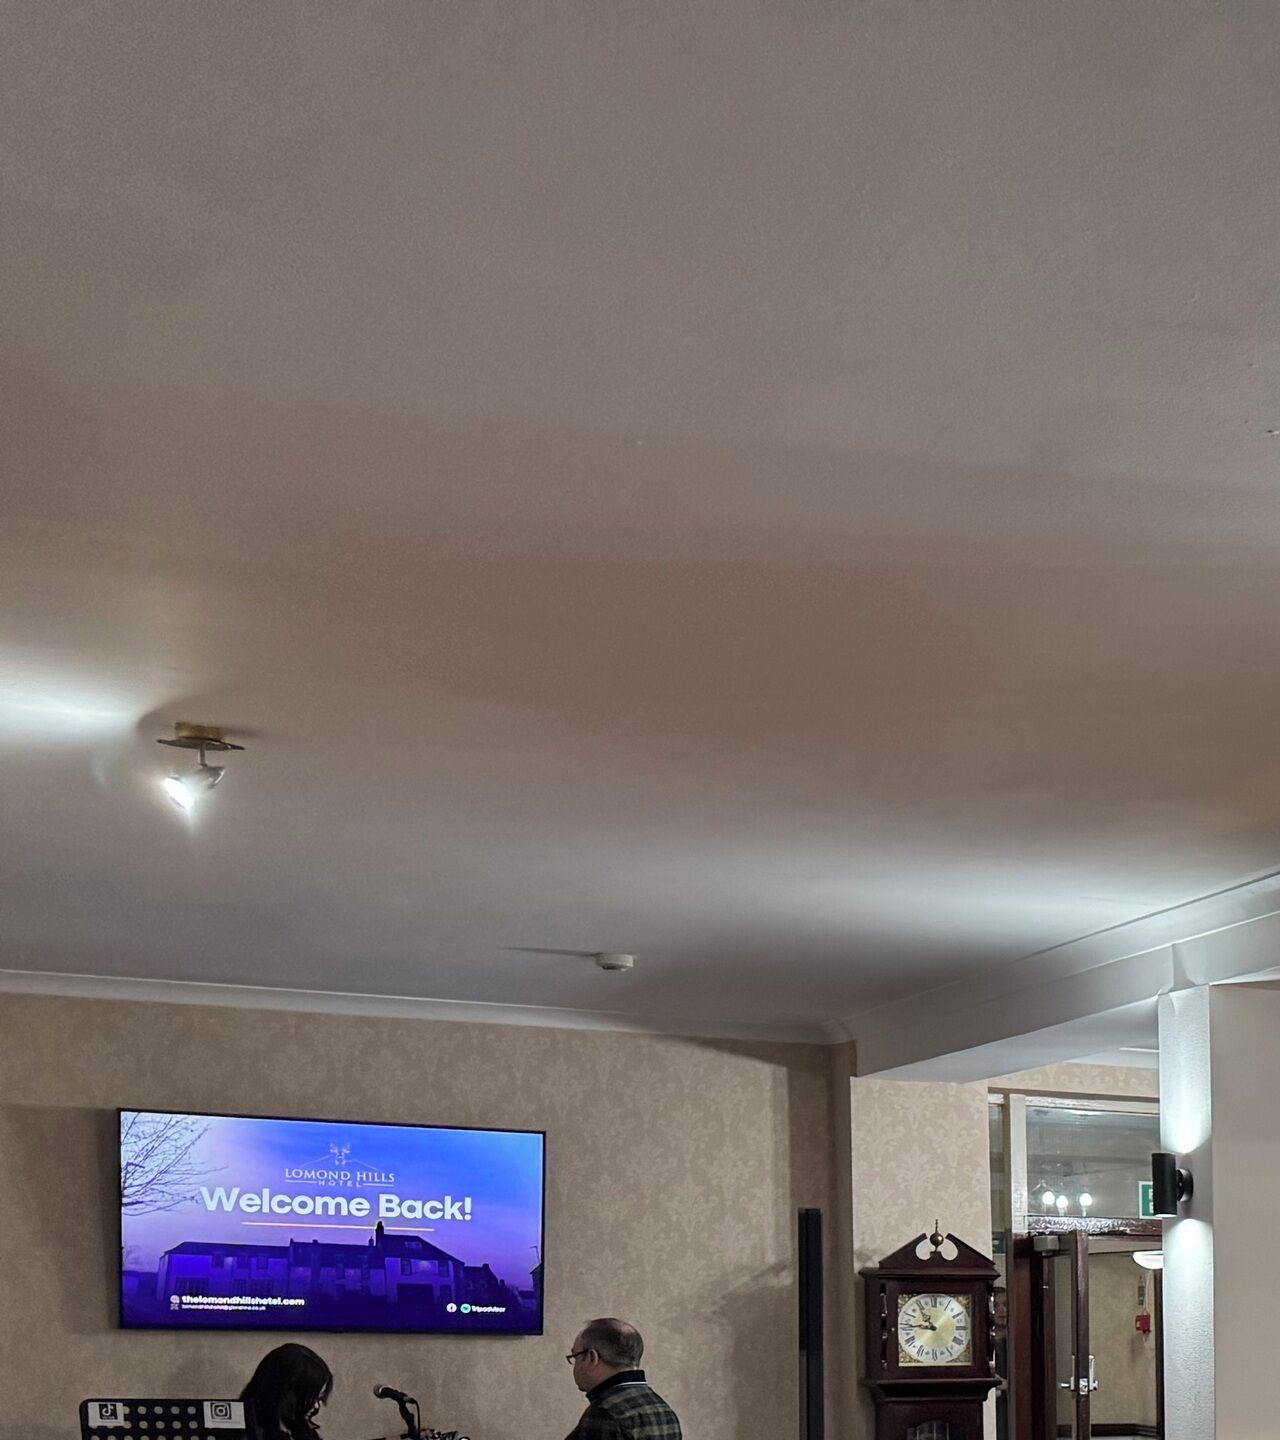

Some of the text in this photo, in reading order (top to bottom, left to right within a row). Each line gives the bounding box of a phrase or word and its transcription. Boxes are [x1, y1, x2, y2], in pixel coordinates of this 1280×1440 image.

[285, 1168, 395, 1183] LOMOND HILLS
[318, 1180, 362, 1188] HOTEL
[201, 1186, 472, 1221] Welcome Back!
[181, 1295, 305, 1306] thelomondhillshotel.com
